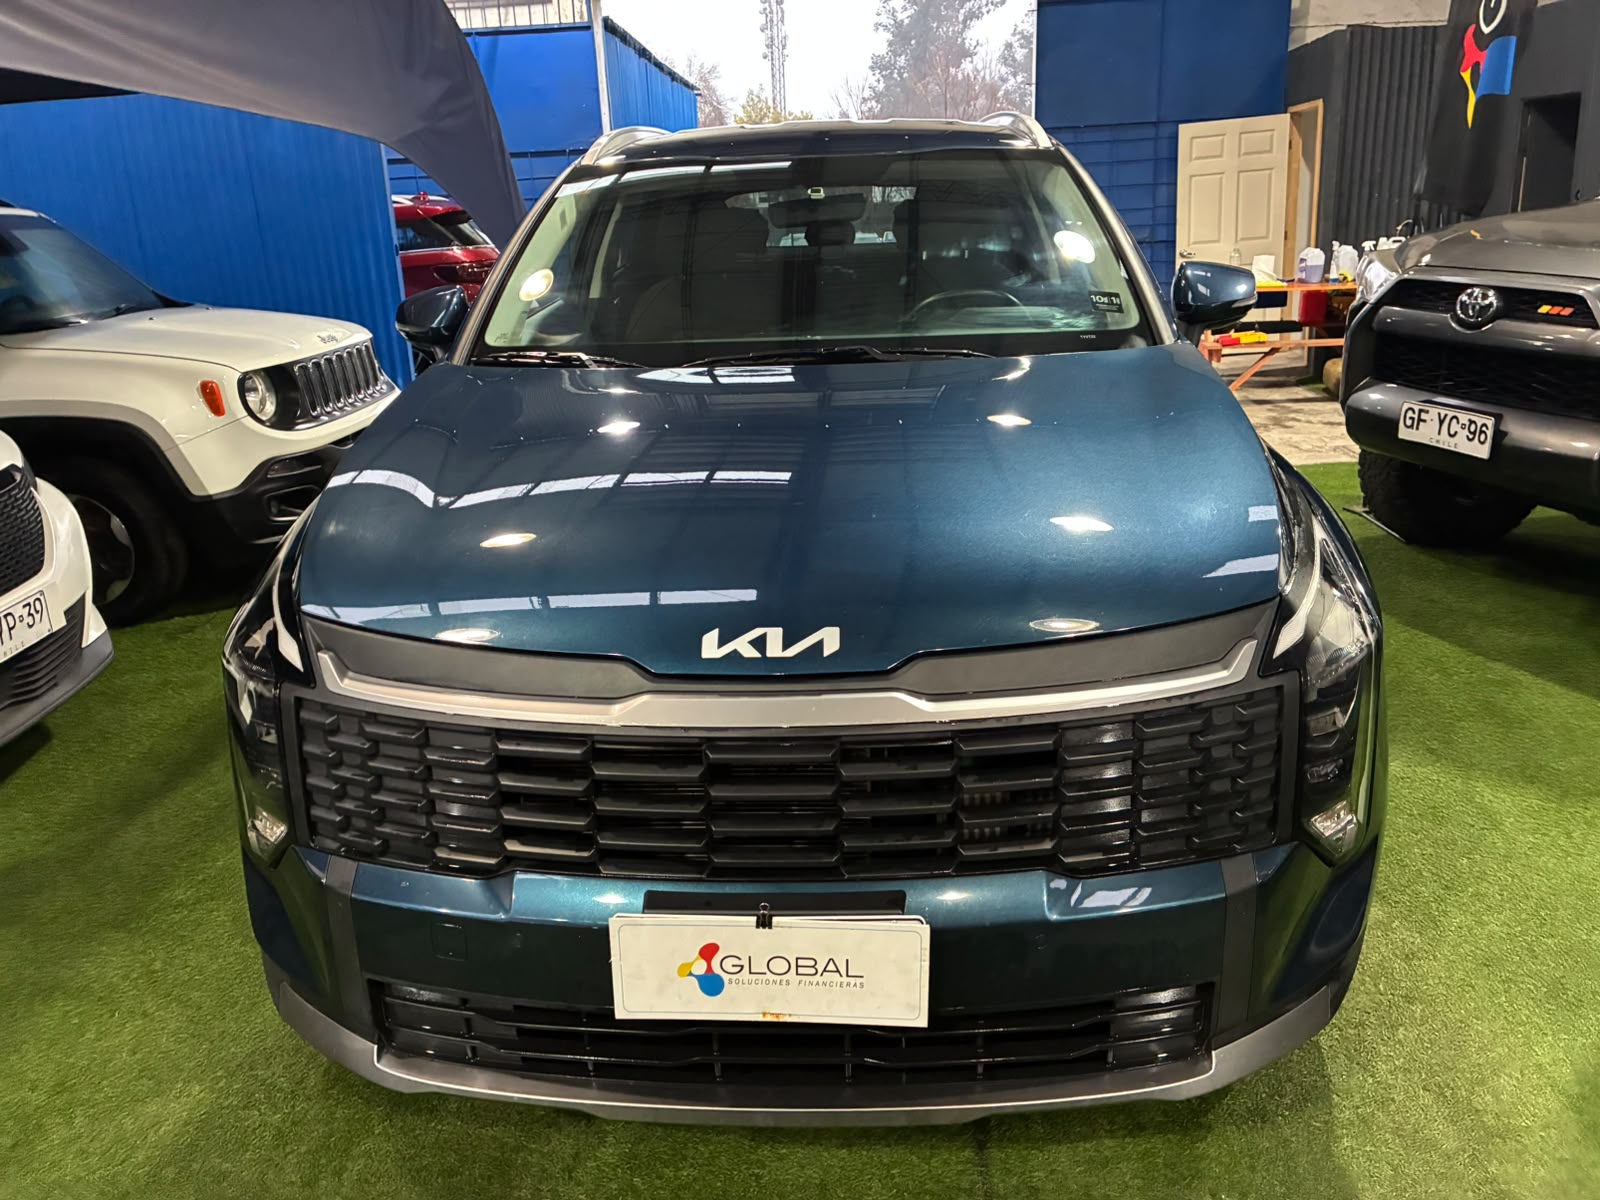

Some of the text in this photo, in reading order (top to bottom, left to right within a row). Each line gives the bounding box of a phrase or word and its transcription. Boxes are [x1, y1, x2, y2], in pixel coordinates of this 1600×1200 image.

[701, 626, 840, 658] KIA
[719, 954, 864, 978] GLOBAL
[727, 977, 865, 989] SOLUCIONES FINANCIERAS
